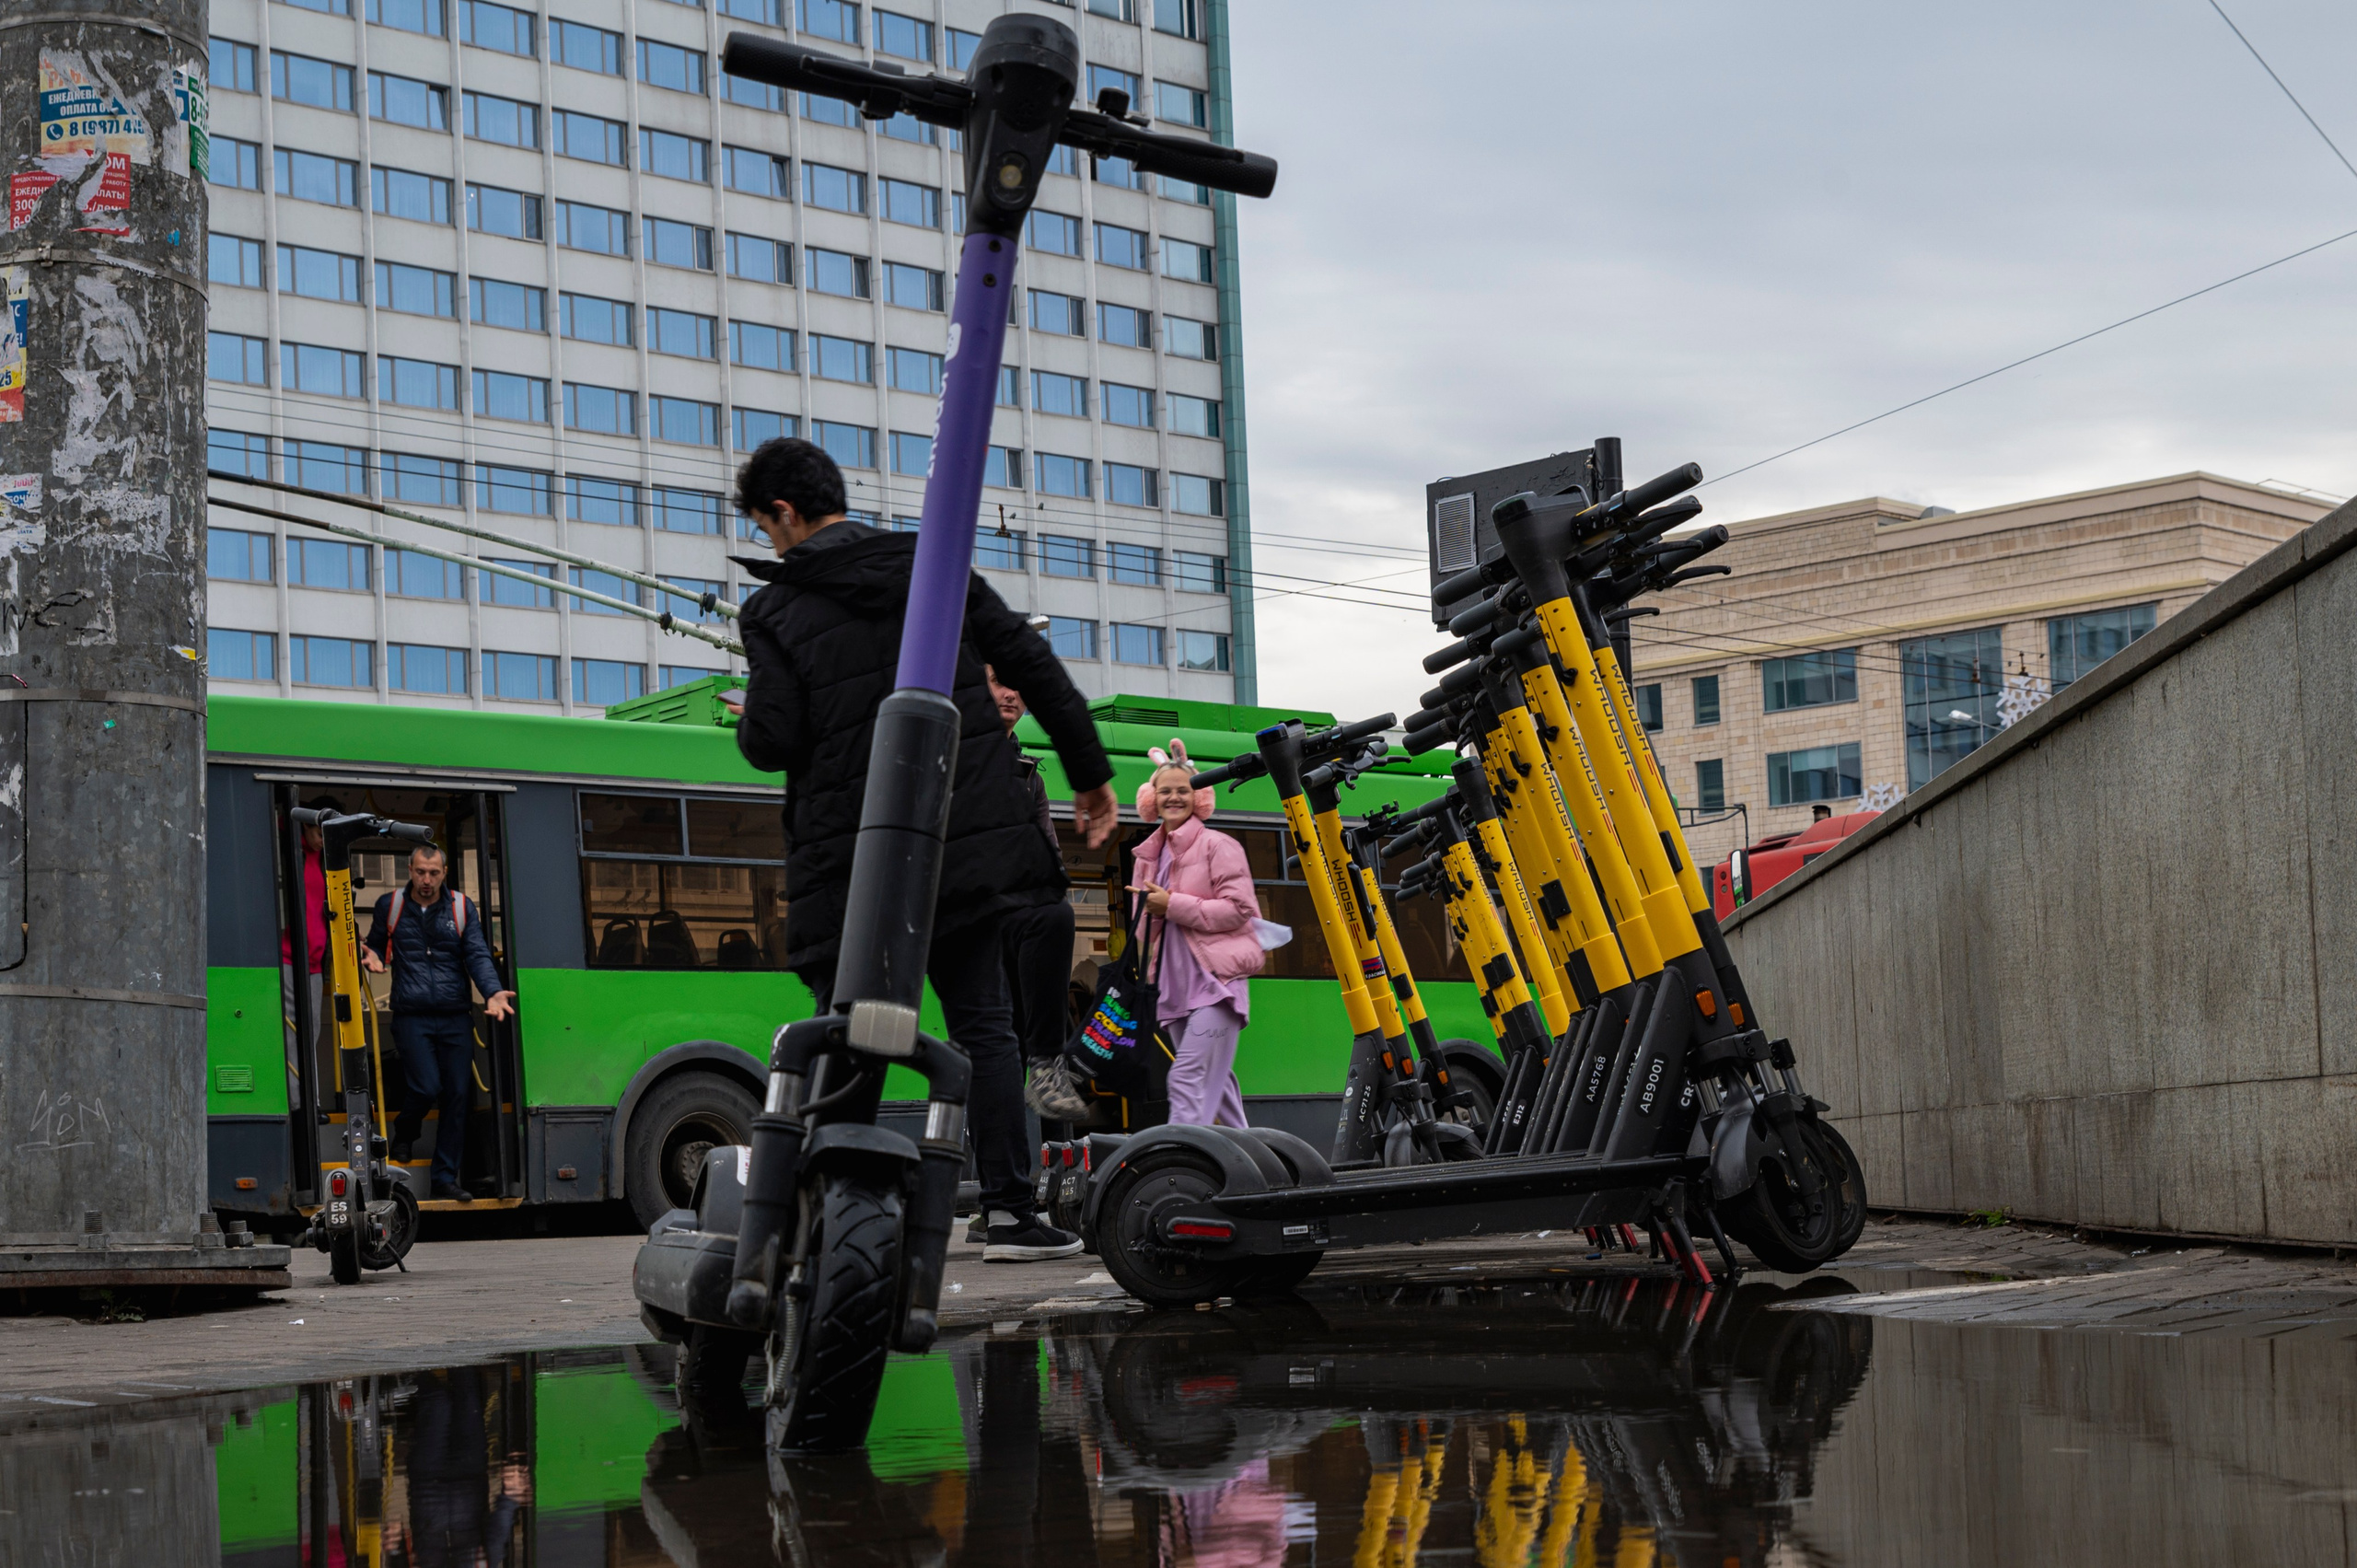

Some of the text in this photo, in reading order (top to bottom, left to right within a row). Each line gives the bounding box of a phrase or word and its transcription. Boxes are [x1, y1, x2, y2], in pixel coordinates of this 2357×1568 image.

[60, 103, 98, 116] ОПЛАТА
[69, 122, 78, 136] 8
[1590, 669, 1631, 765] WHOOSH
[1611, 664, 1649, 750] WHOOSH
[1569, 726, 1606, 810] WHOOSH
[1541, 762, 1574, 839] WHOOSH
[342, 881, 354, 941] WHOOSH
[1331, 859, 1357, 923] WHOOSH
[1508, 862, 1534, 920] WHOOSH
[1586, 1055, 1606, 1102] AA5768
[1640, 1058, 1665, 1113] AB9001
[331, 1202, 348, 1213] ES
[1062, 1177, 1075, 1186] AC7
[331, 1214, 348, 1225] 59
